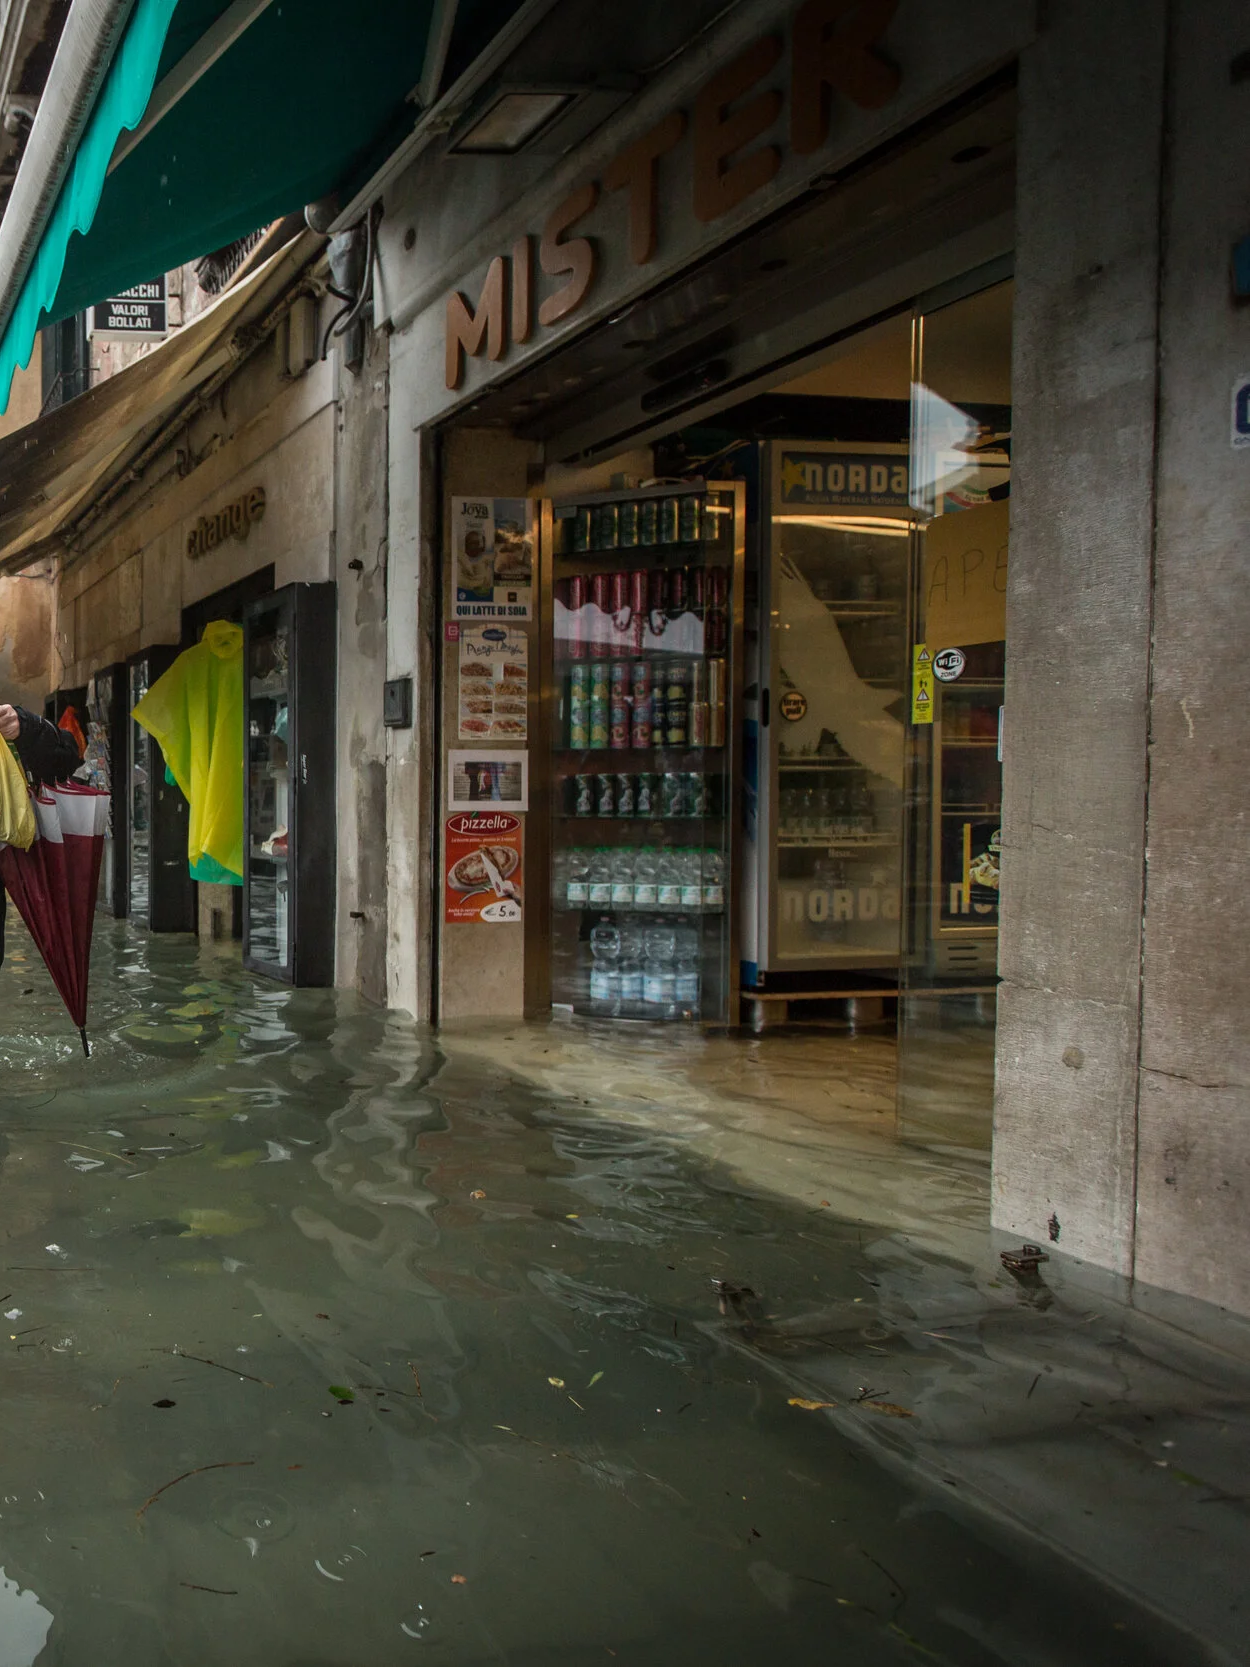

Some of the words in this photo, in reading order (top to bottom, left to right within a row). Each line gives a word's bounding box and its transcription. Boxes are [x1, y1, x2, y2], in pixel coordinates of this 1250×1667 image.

[446, 0, 901, 389] MISTER
[117, 284, 159, 298] ACCHI
[111, 304, 148, 316] VALORI
[108, 316, 151, 329] BOLLATI
[456, 605, 471, 616] QUI
[472, 605, 496, 616] LATTE
[497, 605, 506, 616] DI
[508, 605, 528, 616] SOIA
[940, 670, 957, 678] ZONE
[461, 815, 508, 833] pizzella
